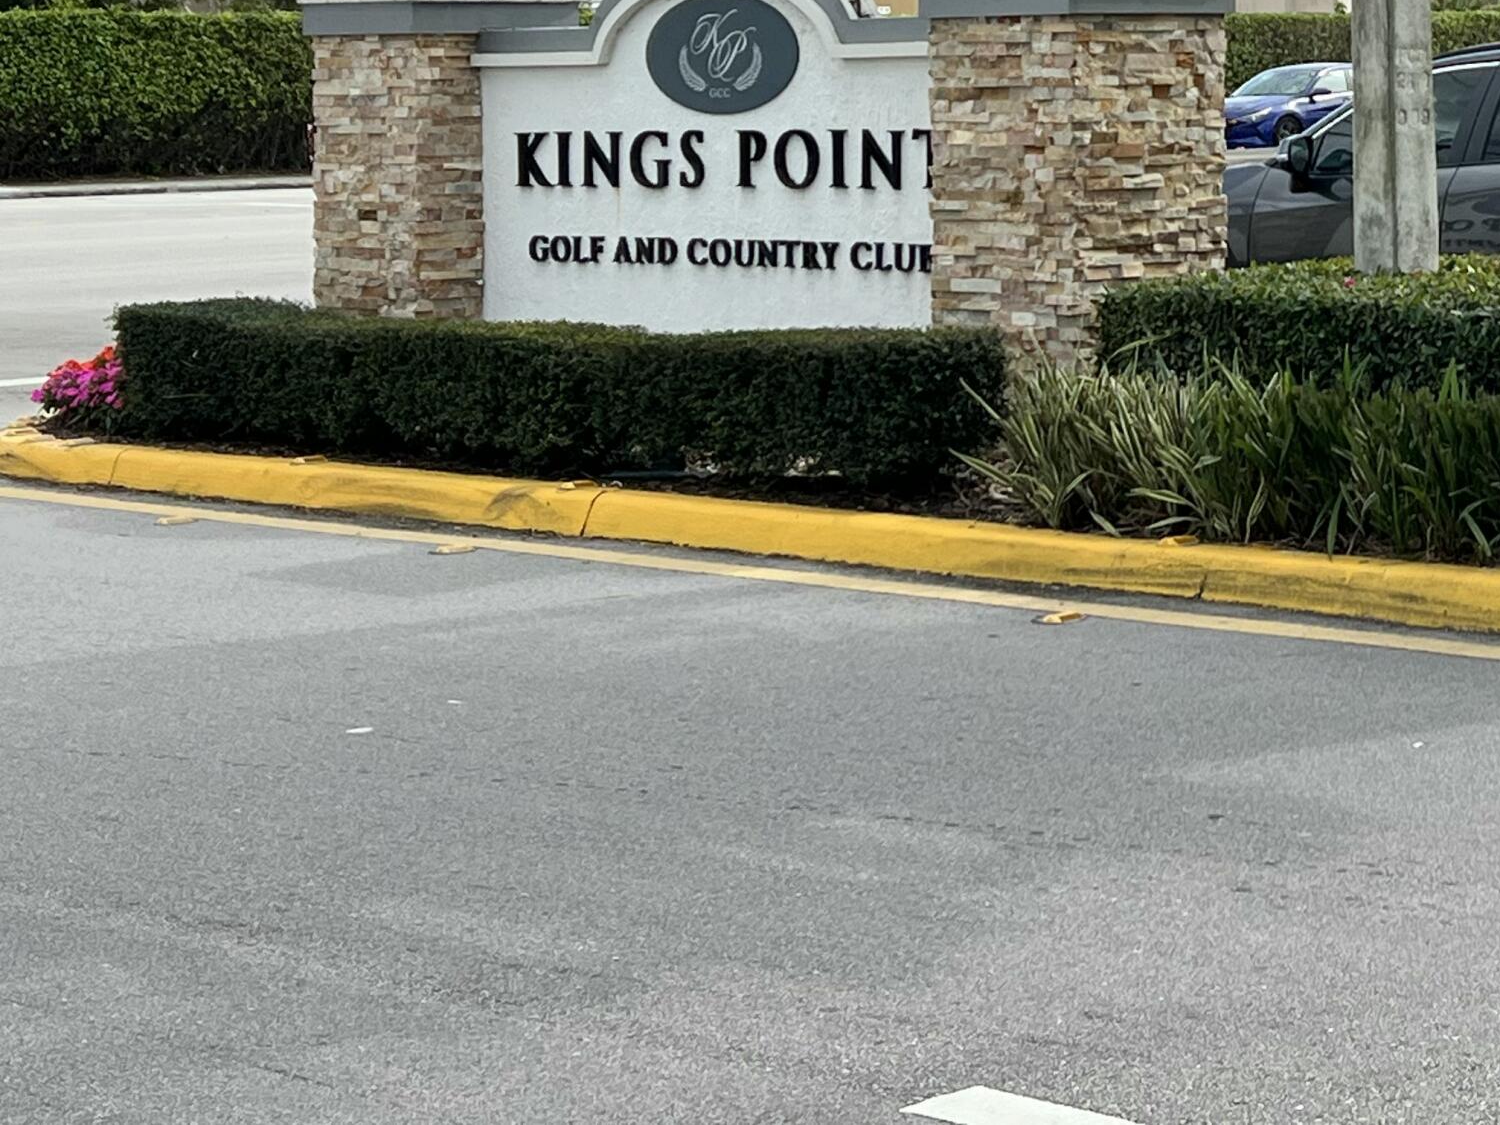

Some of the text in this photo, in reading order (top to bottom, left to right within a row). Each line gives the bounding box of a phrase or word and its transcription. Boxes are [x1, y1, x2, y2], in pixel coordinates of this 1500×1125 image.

[708, 87, 731, 98] GCC
[514, 129, 706, 189] KINGS
[528, 235, 605, 264] GOLF
[613, 236, 678, 266] AND
[686, 238, 840, 271] COUNTRY
